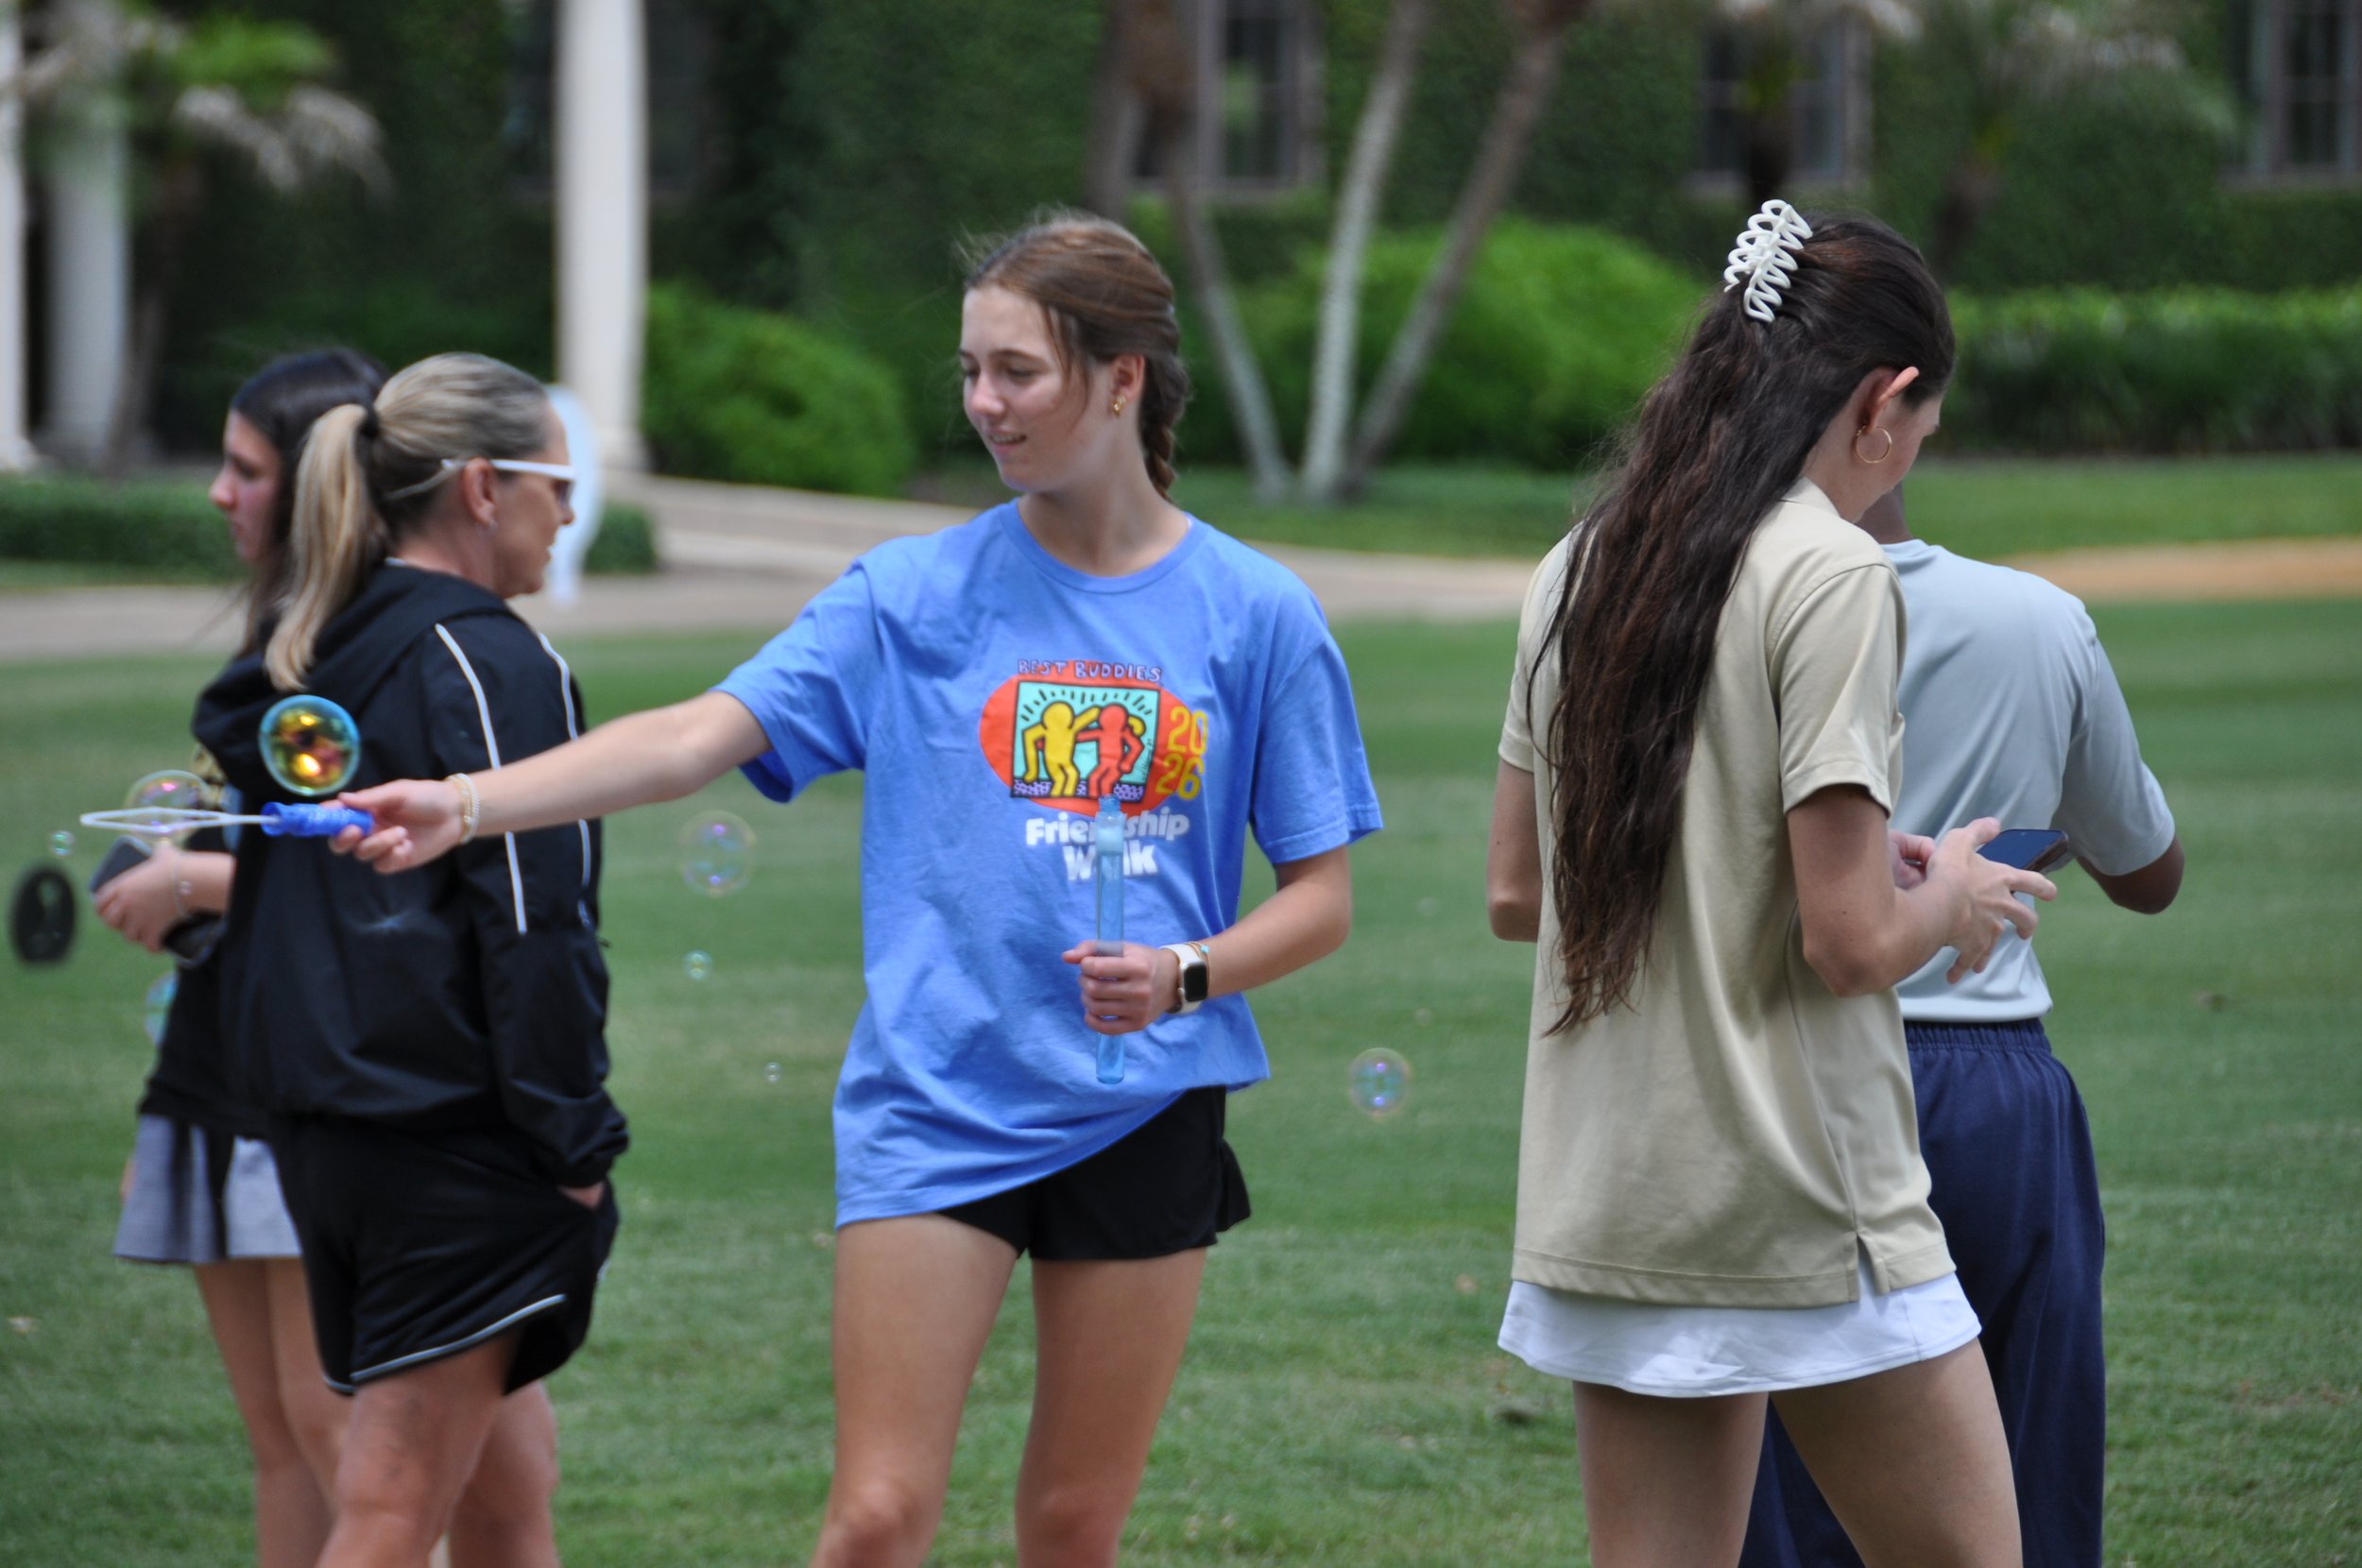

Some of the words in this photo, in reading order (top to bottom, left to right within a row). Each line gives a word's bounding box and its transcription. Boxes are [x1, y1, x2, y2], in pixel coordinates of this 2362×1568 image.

[1018, 660, 1067, 675] BEST
[1075, 661, 1163, 682] BUDDIES
[1167, 706, 1208, 755] 20
[1155, 754, 1205, 800] 26
[1025, 807, 1190, 845] Frieship
[1062, 840, 1158, 880] Wlk
